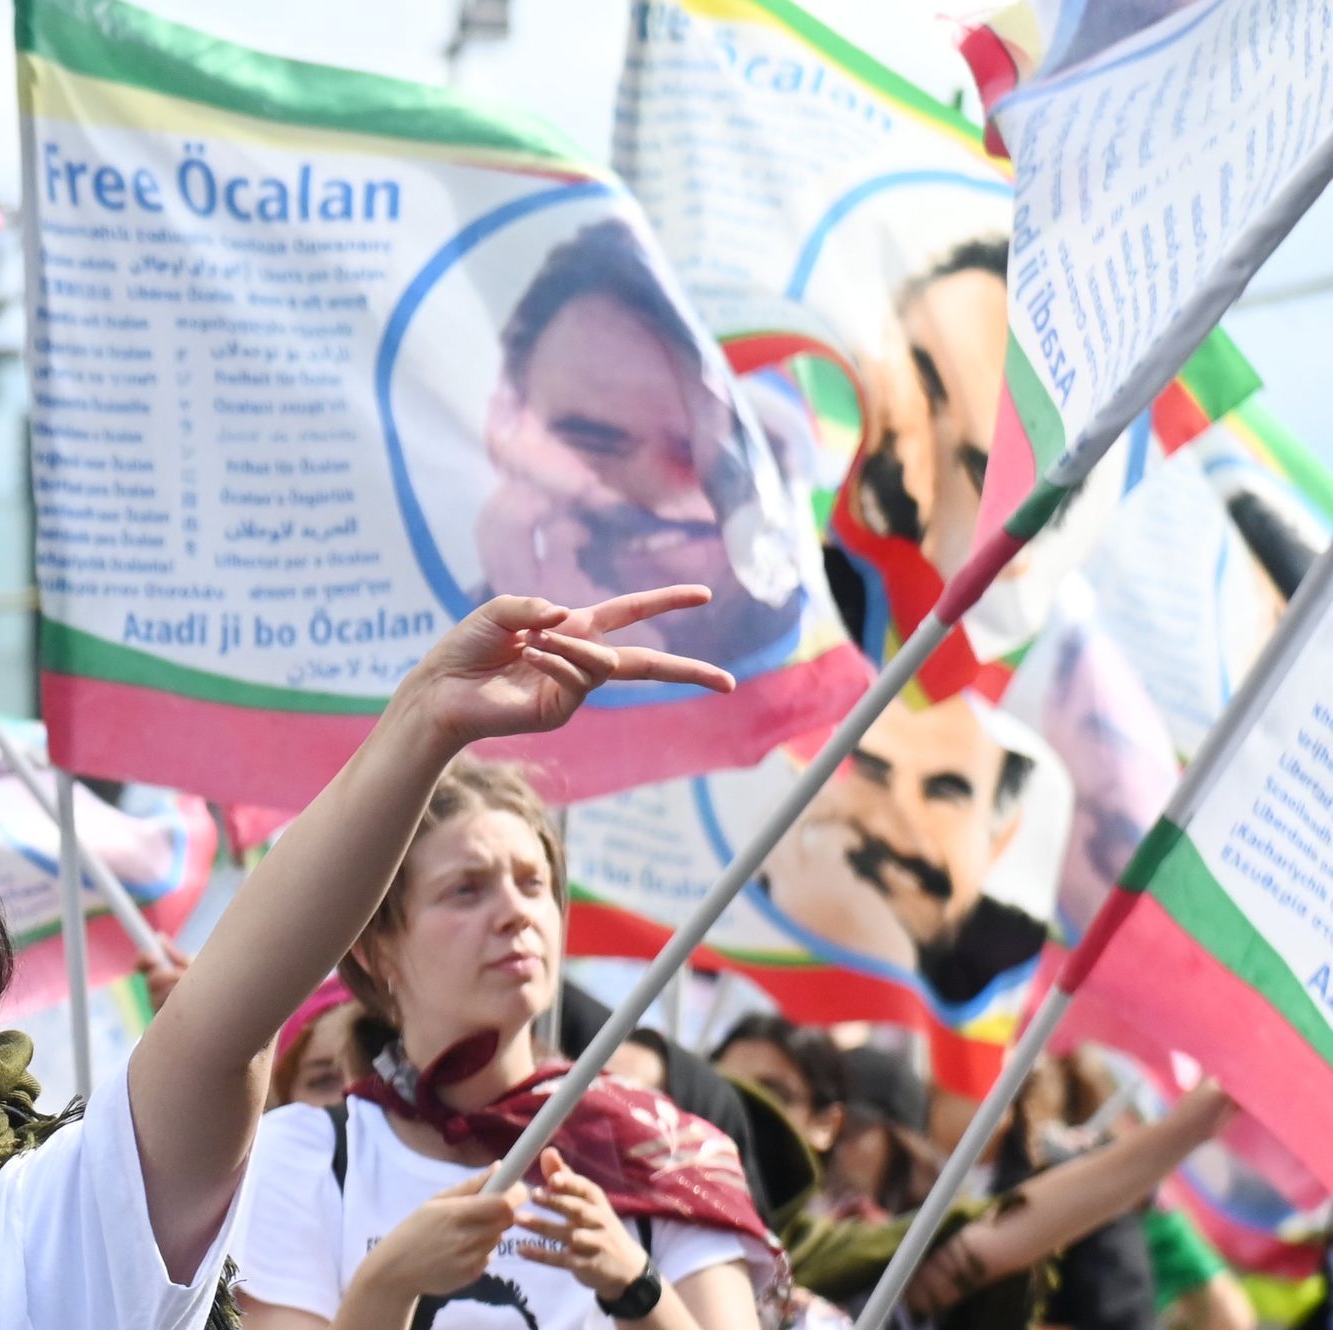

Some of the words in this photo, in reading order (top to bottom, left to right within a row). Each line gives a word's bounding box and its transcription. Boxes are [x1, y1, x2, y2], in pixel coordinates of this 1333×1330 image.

[42, 140, 165, 214] Free
[176, 140, 403, 224] Öcalan
[121, 610, 209, 648] Azadî
[217, 614, 244, 656] ji
[253, 615, 297, 648] bo
[307, 605, 435, 648] Öcalan
